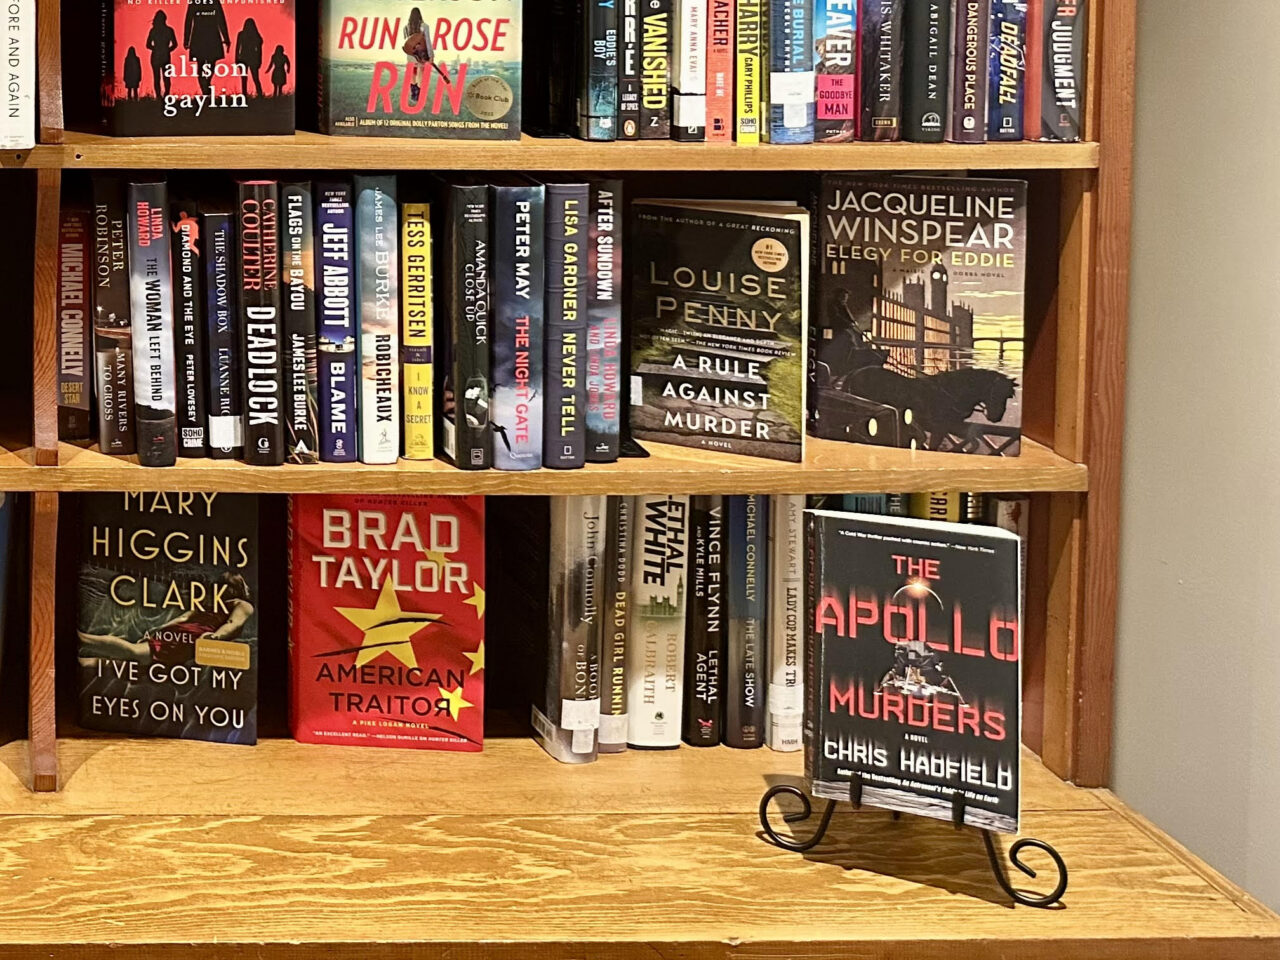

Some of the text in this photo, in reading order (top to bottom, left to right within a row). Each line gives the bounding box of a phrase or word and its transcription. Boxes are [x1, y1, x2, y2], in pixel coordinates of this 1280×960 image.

[338, 17, 510, 51] RUN ROSE
[164, 55, 248, 78] alison
[642, 12, 668, 109] VANISHED
[163, 87, 248, 117] gaylin
[366, 61, 467, 115] RUN
[827, 190, 1015, 219] JACQUELINE
[826, 215, 1014, 249] WINSPEAR
[826, 244, 1014, 268] ELEGY FOR EDDIE
[649, 261, 787, 299] LOUISE
[561, 200, 578, 437] LISA GARDNER NEVER TELL
[656, 296, 782, 332] PENNY
[247, 306, 279, 426] DEADLOCK
[672, 354, 761, 379] A RULE
[662, 382, 772, 410] AGAINST
[663, 411, 770, 440] MURDER
[93, 526, 248, 567] HIGGINS
[322, 509, 460, 553] BRAD
[312, 555, 469, 594] TAYLOR
[891, 554, 941, 579] THE
[110, 575, 229, 614] CLARK
[815, 595, 1019, 661] APOLLO
[98, 659, 243, 690] I'VE GOT MY
[315, 663, 465, 688] AMERICAN
[93, 696, 244, 729] EYES ON YOU
[830, 679, 1007, 742] MURDERS
[824, 738, 888, 767] CHRIS
[900, 748, 1013, 790] HADFIELD
